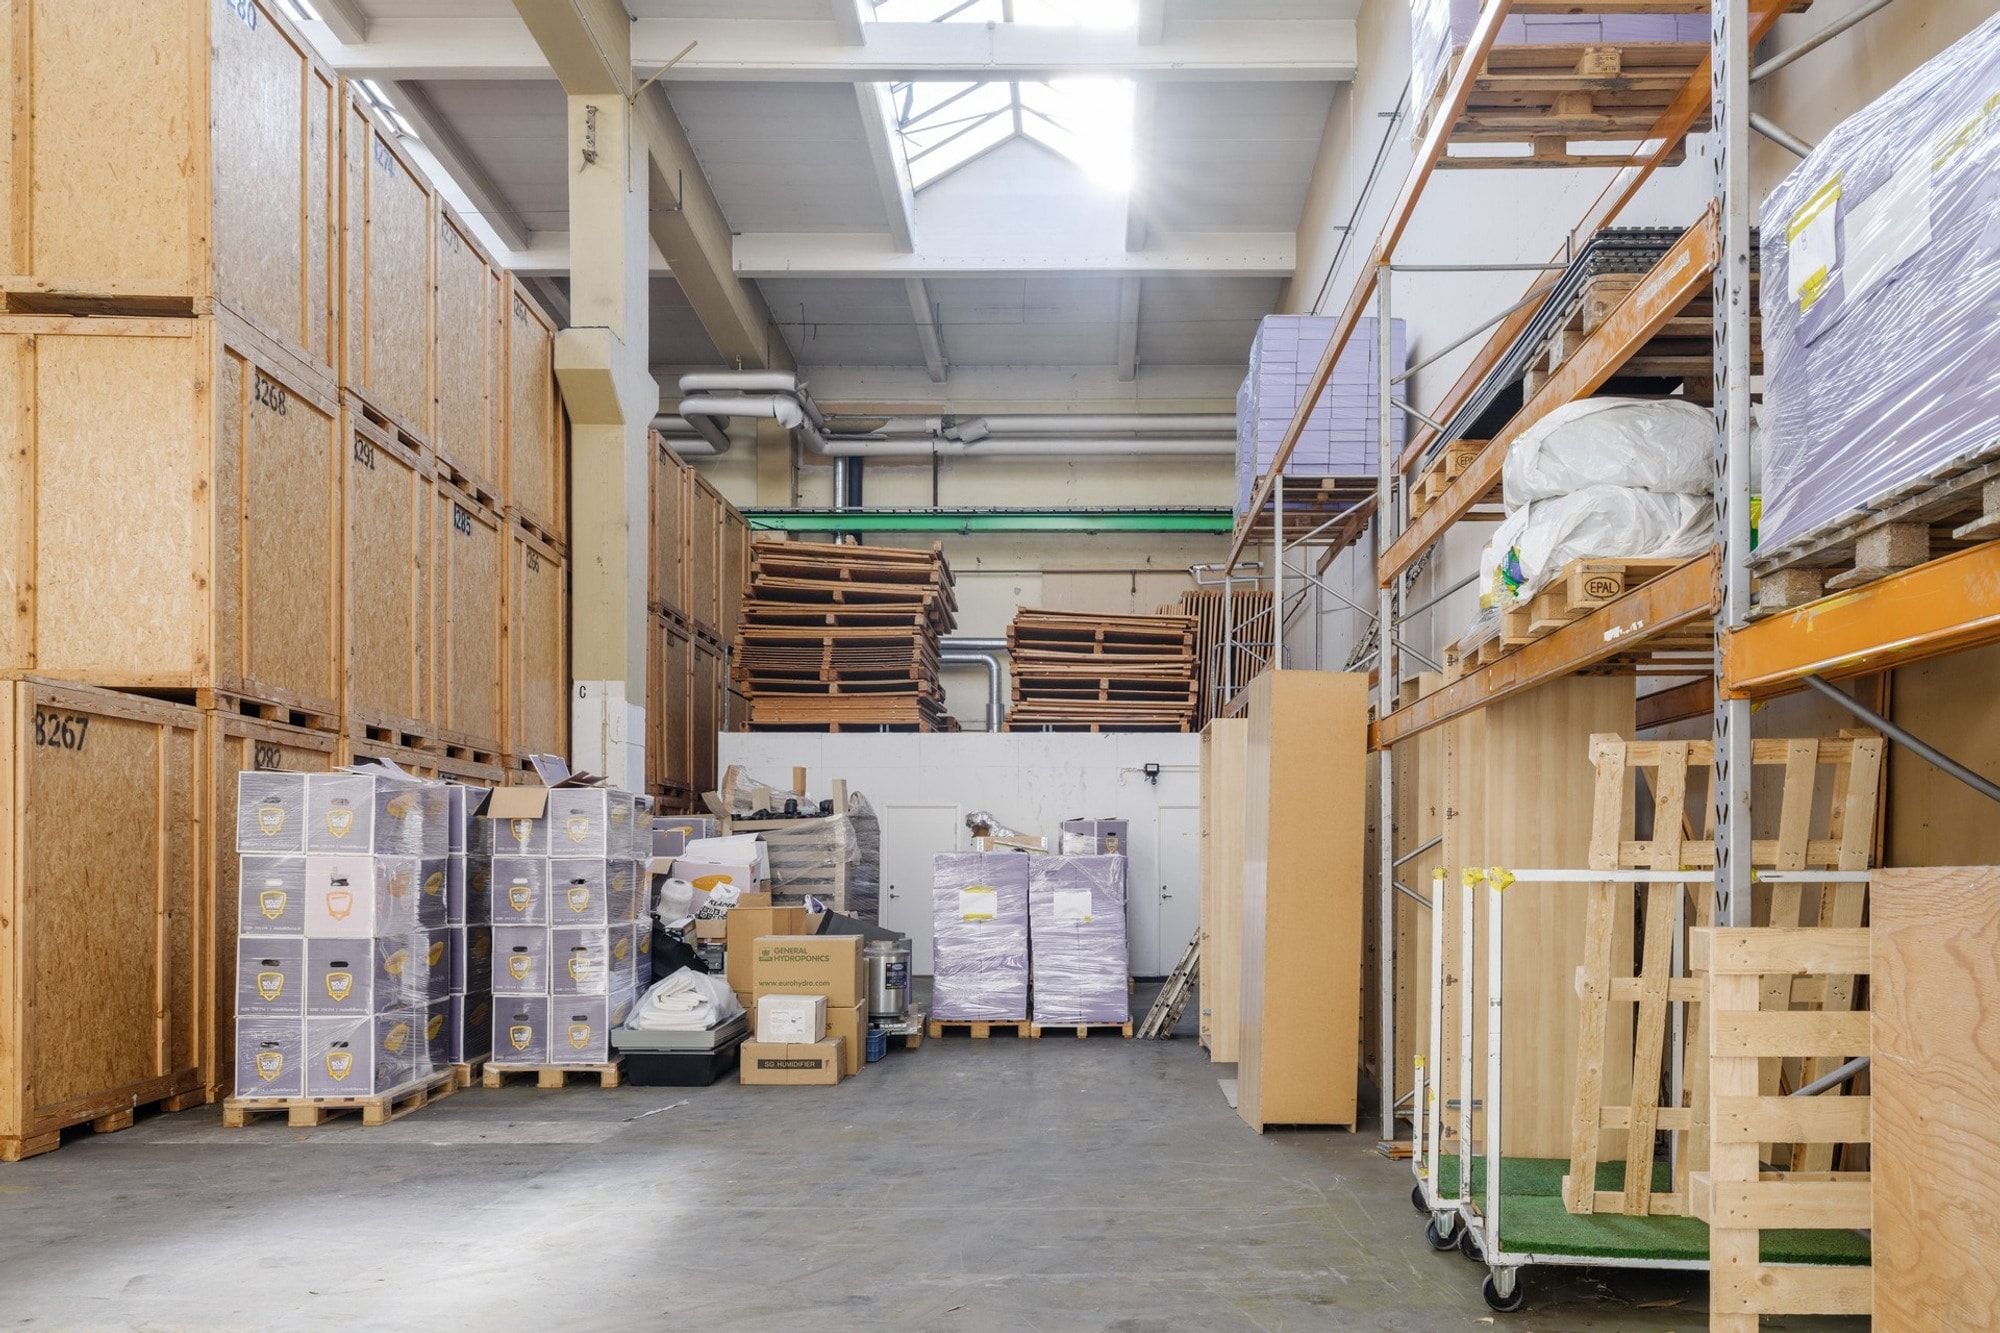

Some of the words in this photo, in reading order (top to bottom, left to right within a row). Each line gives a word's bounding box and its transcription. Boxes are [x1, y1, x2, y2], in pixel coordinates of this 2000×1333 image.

[1590, 581, 1615, 594] EPAL
[579, 685, 587, 699] C
[35, 710, 89, 751] B267
[774, 947, 808, 955] GENERAL
[758, 980, 831, 988] www.eurohydro.com
